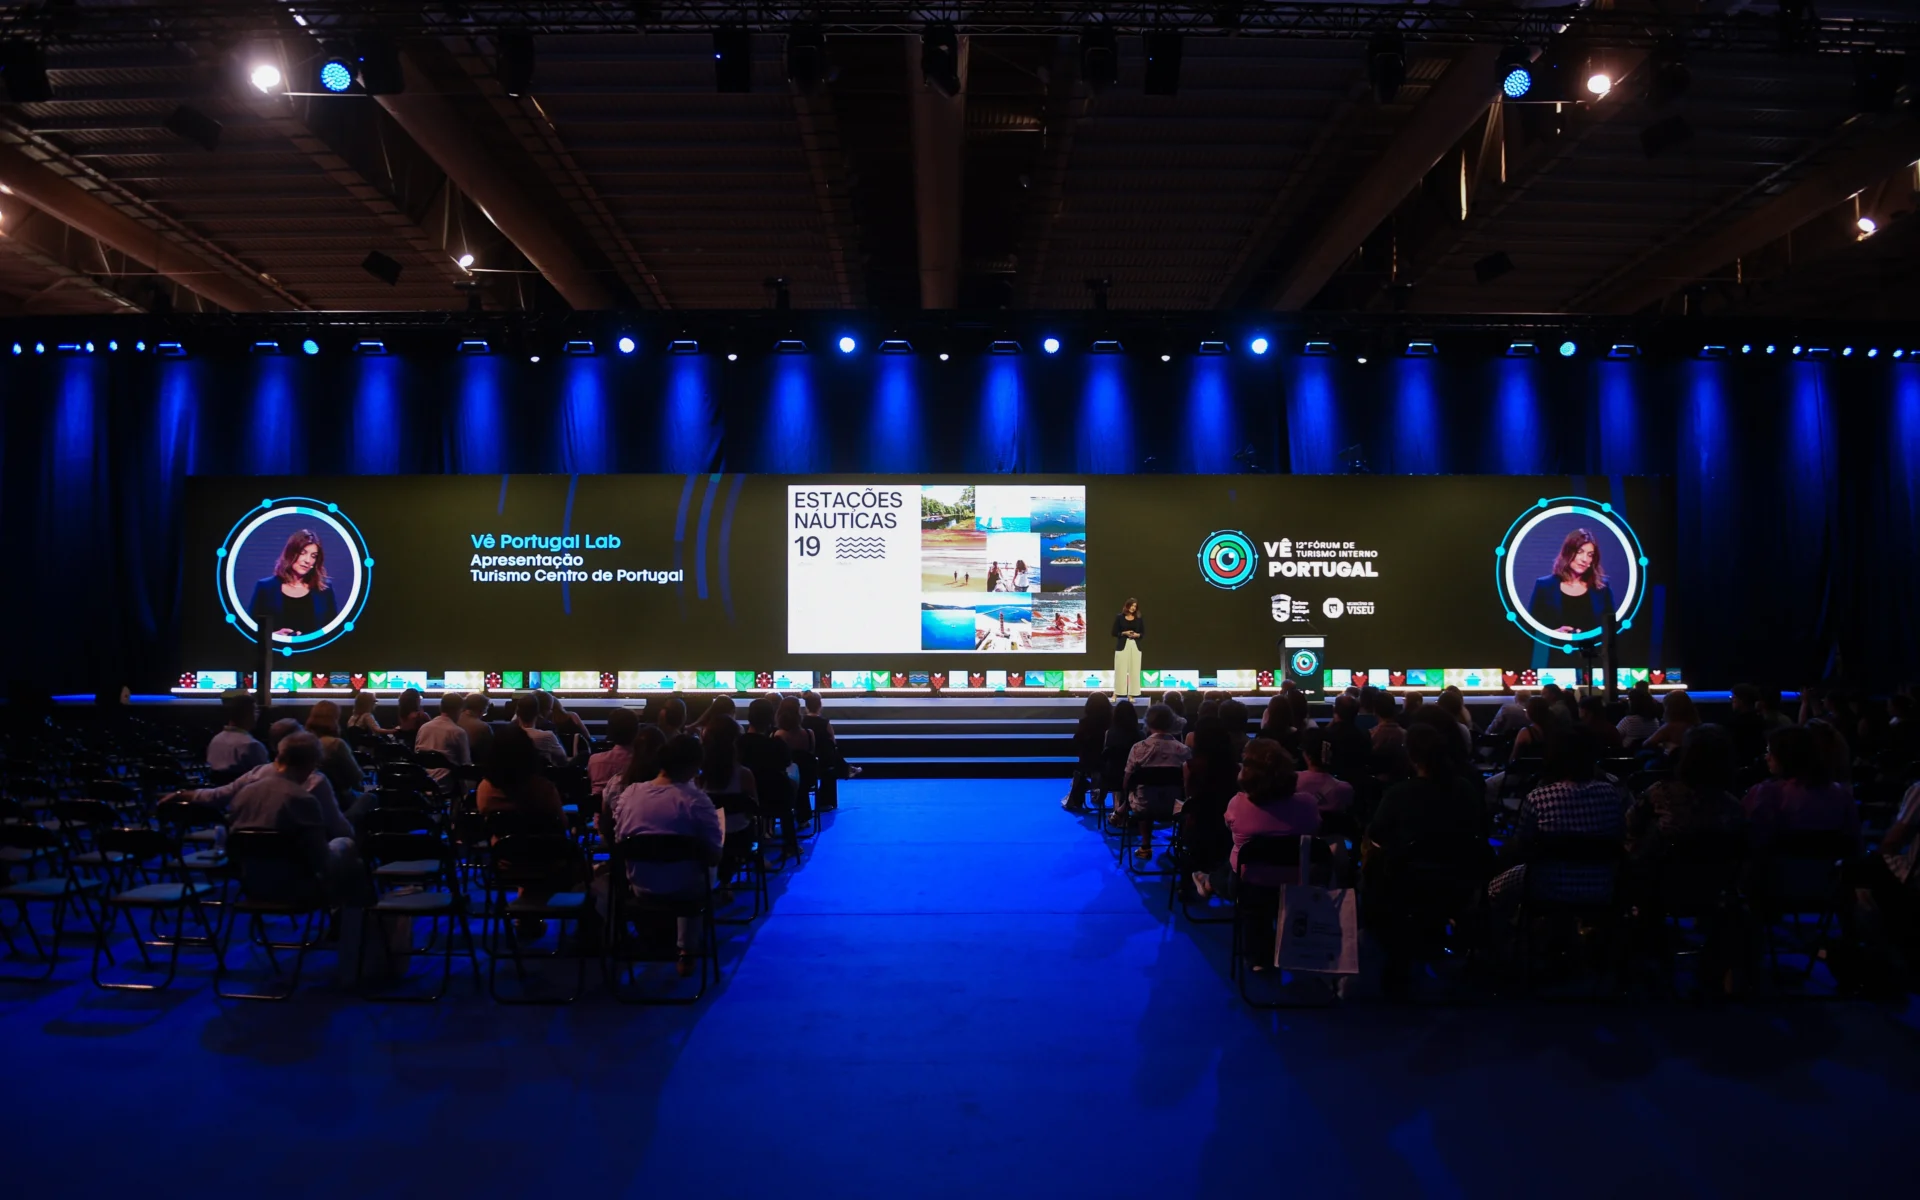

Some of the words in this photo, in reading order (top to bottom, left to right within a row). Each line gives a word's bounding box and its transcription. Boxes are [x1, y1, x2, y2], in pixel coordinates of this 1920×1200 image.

[795, 488, 903, 511] ESTAÇÕES
[795, 510, 897, 529] NÁUTICAS
[470, 533, 496, 549] Vê
[500, 534, 580, 551] Portugal
[585, 534, 621, 549] Lab
[794, 536, 821, 557] 19
[1263, 538, 1292, 558] VÊ
[1308, 540, 1340, 549] FÓRUM
[1343, 541, 1355, 549] DE
[470, 554, 584, 568] Apresentação
[1296, 550, 1336, 558] TURISMO
[1339, 550, 1378, 558] INTERNO
[470, 569, 531, 582] Turismo
[534, 569, 588, 582] Centro
[592, 569, 613, 582] de
[617, 569, 683, 584] Portugal
[1269, 561, 1379, 578] PORTUGAL
[1346, 606, 1375, 614] VISEU
